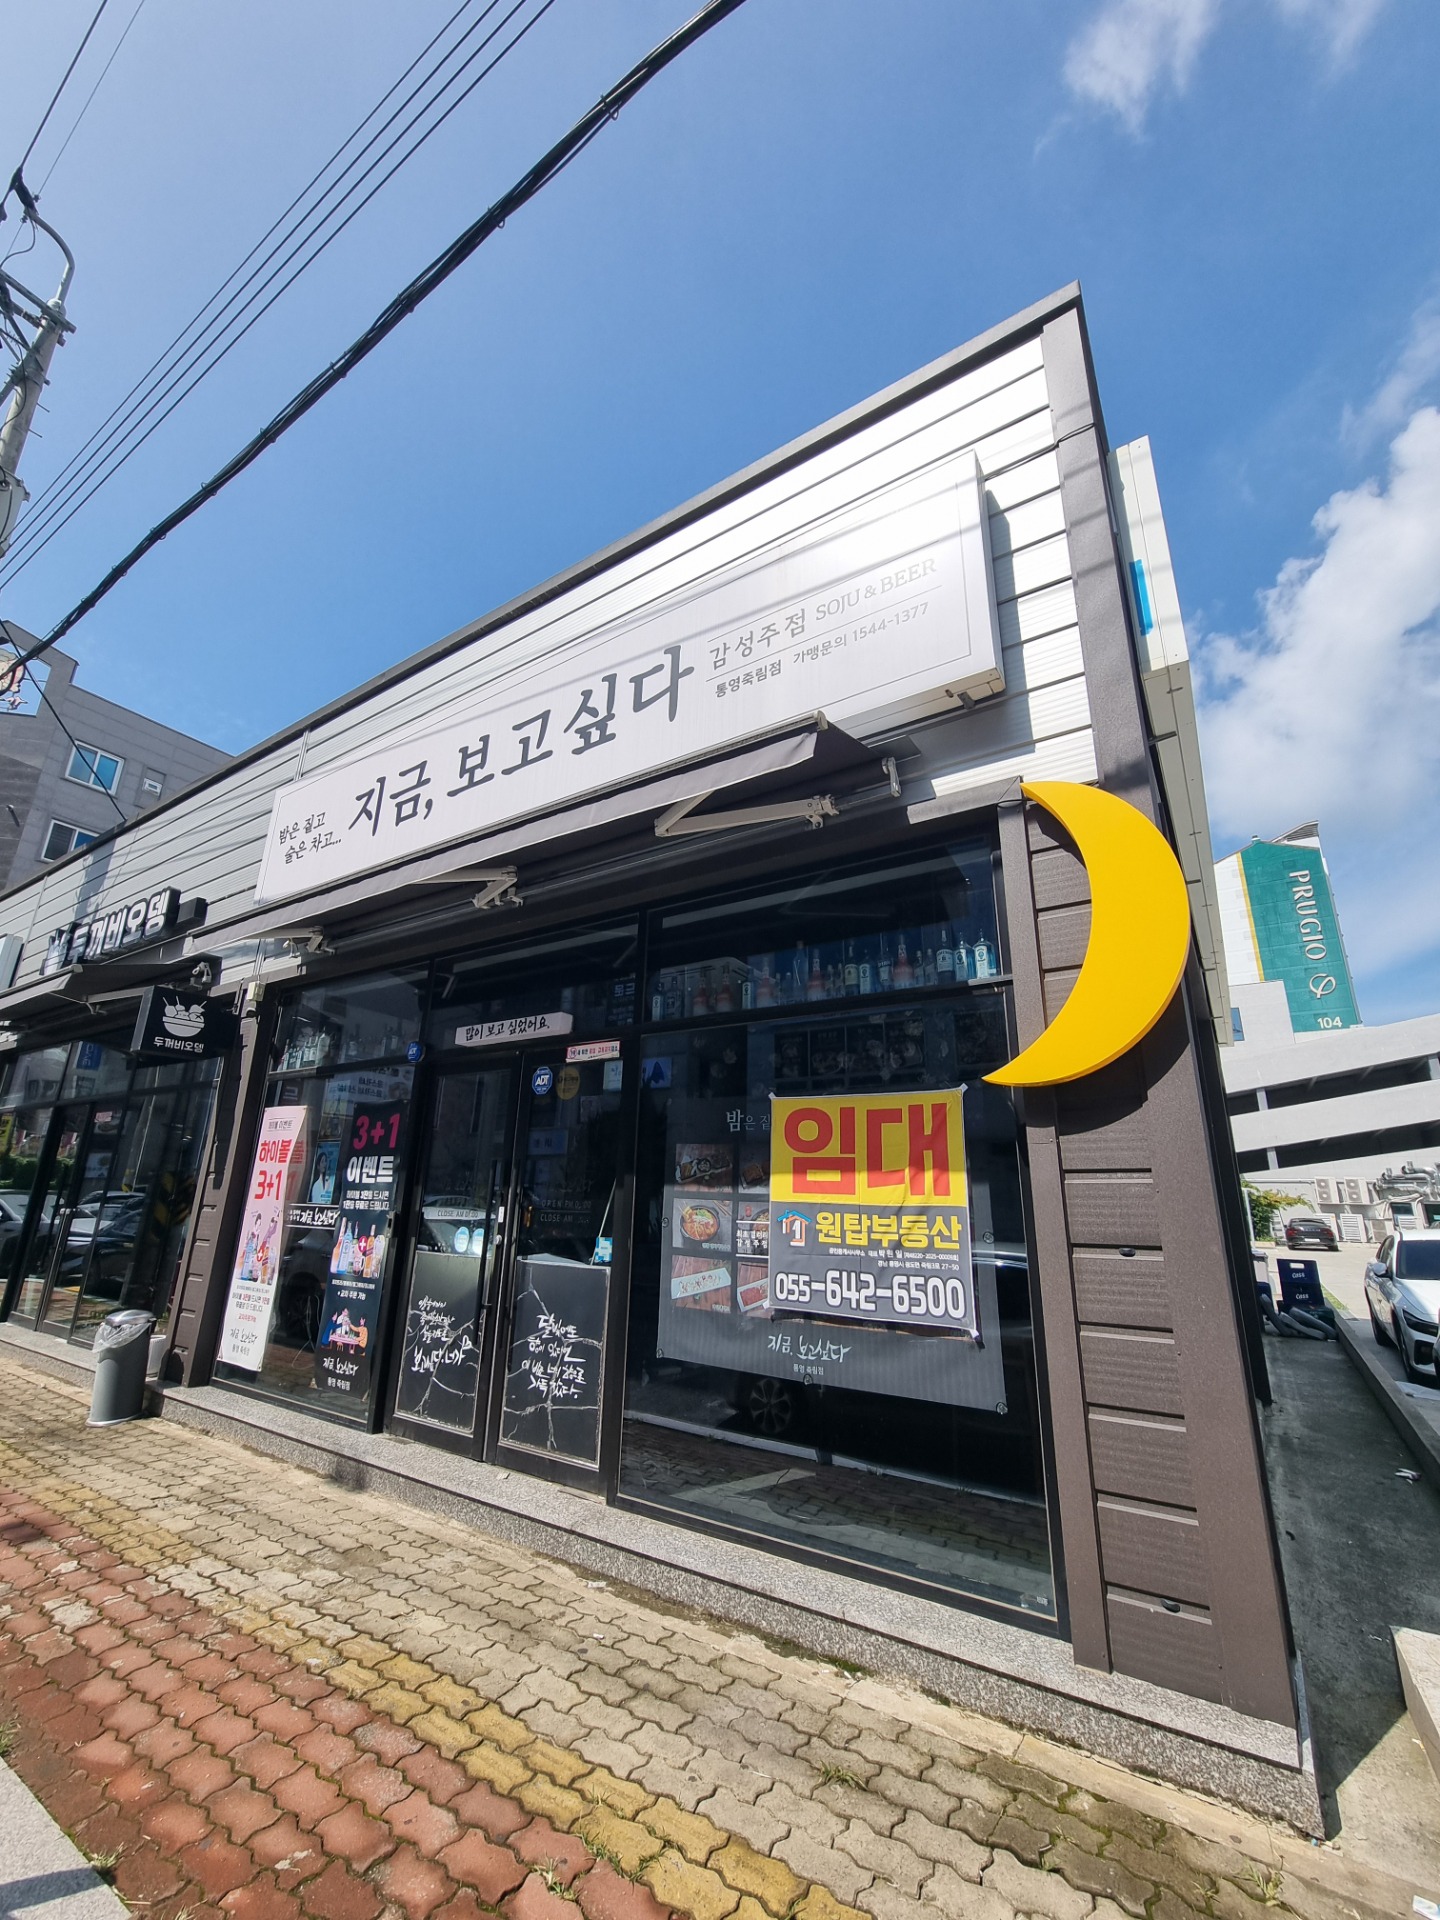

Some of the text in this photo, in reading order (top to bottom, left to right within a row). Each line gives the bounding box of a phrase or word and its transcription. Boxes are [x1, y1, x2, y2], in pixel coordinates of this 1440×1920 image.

[815, 589, 860, 621] SOJU
[864, 585, 877, 599] &
[880, 558, 937, 594] BEER
[715, 602, 929, 698] 통영죽림점 가맹문의 1544-1377
[348, 761, 433, 837] 지금,
[279, 812, 326, 845] 밤은 짙고
[285, 841, 307, 864] 술은
[67, 889, 171, 963] 두꺼비오뎅
[1289, 869, 1327, 961] PRUGIO
[465, 1016, 550, 1041] 많이 보고 싶었어요.
[1317, 1016, 1342, 1029] 104
[154, 1036, 205, 1053] 두꺼비오뎅
[535, 1074, 550, 1087] ADT
[353, 1113, 400, 1150] 3+1
[726, 1109, 756, 1132] 밤은
[259, 1139, 292, 1163] 하이볼
[784, 1102, 950, 1197] 임대
[347, 1155, 394, 1184] 이벤트
[254, 1169, 283, 1201] 3+1
[437, 1209, 454, 1217] CLOSE
[540, 1213, 561, 1222] CLOSE
[815, 1211, 962, 1250] 원탑부동산
[878, 1260, 888, 1268] 경남
[889, 1260, 904, 1269] 통영시
[941, 1263, 959, 1271] 27-50
[775, 1269, 966, 1319] 055-642-6500
[537, 1313, 579, 1338] 달빛에도
[527, 1336, 545, 1353] 향이
[796, 1335, 852, 1363] 보고싶다
[793, 1363, 824, 1375] 통영 죽림점
[527, 1374, 548, 1398] 가득
